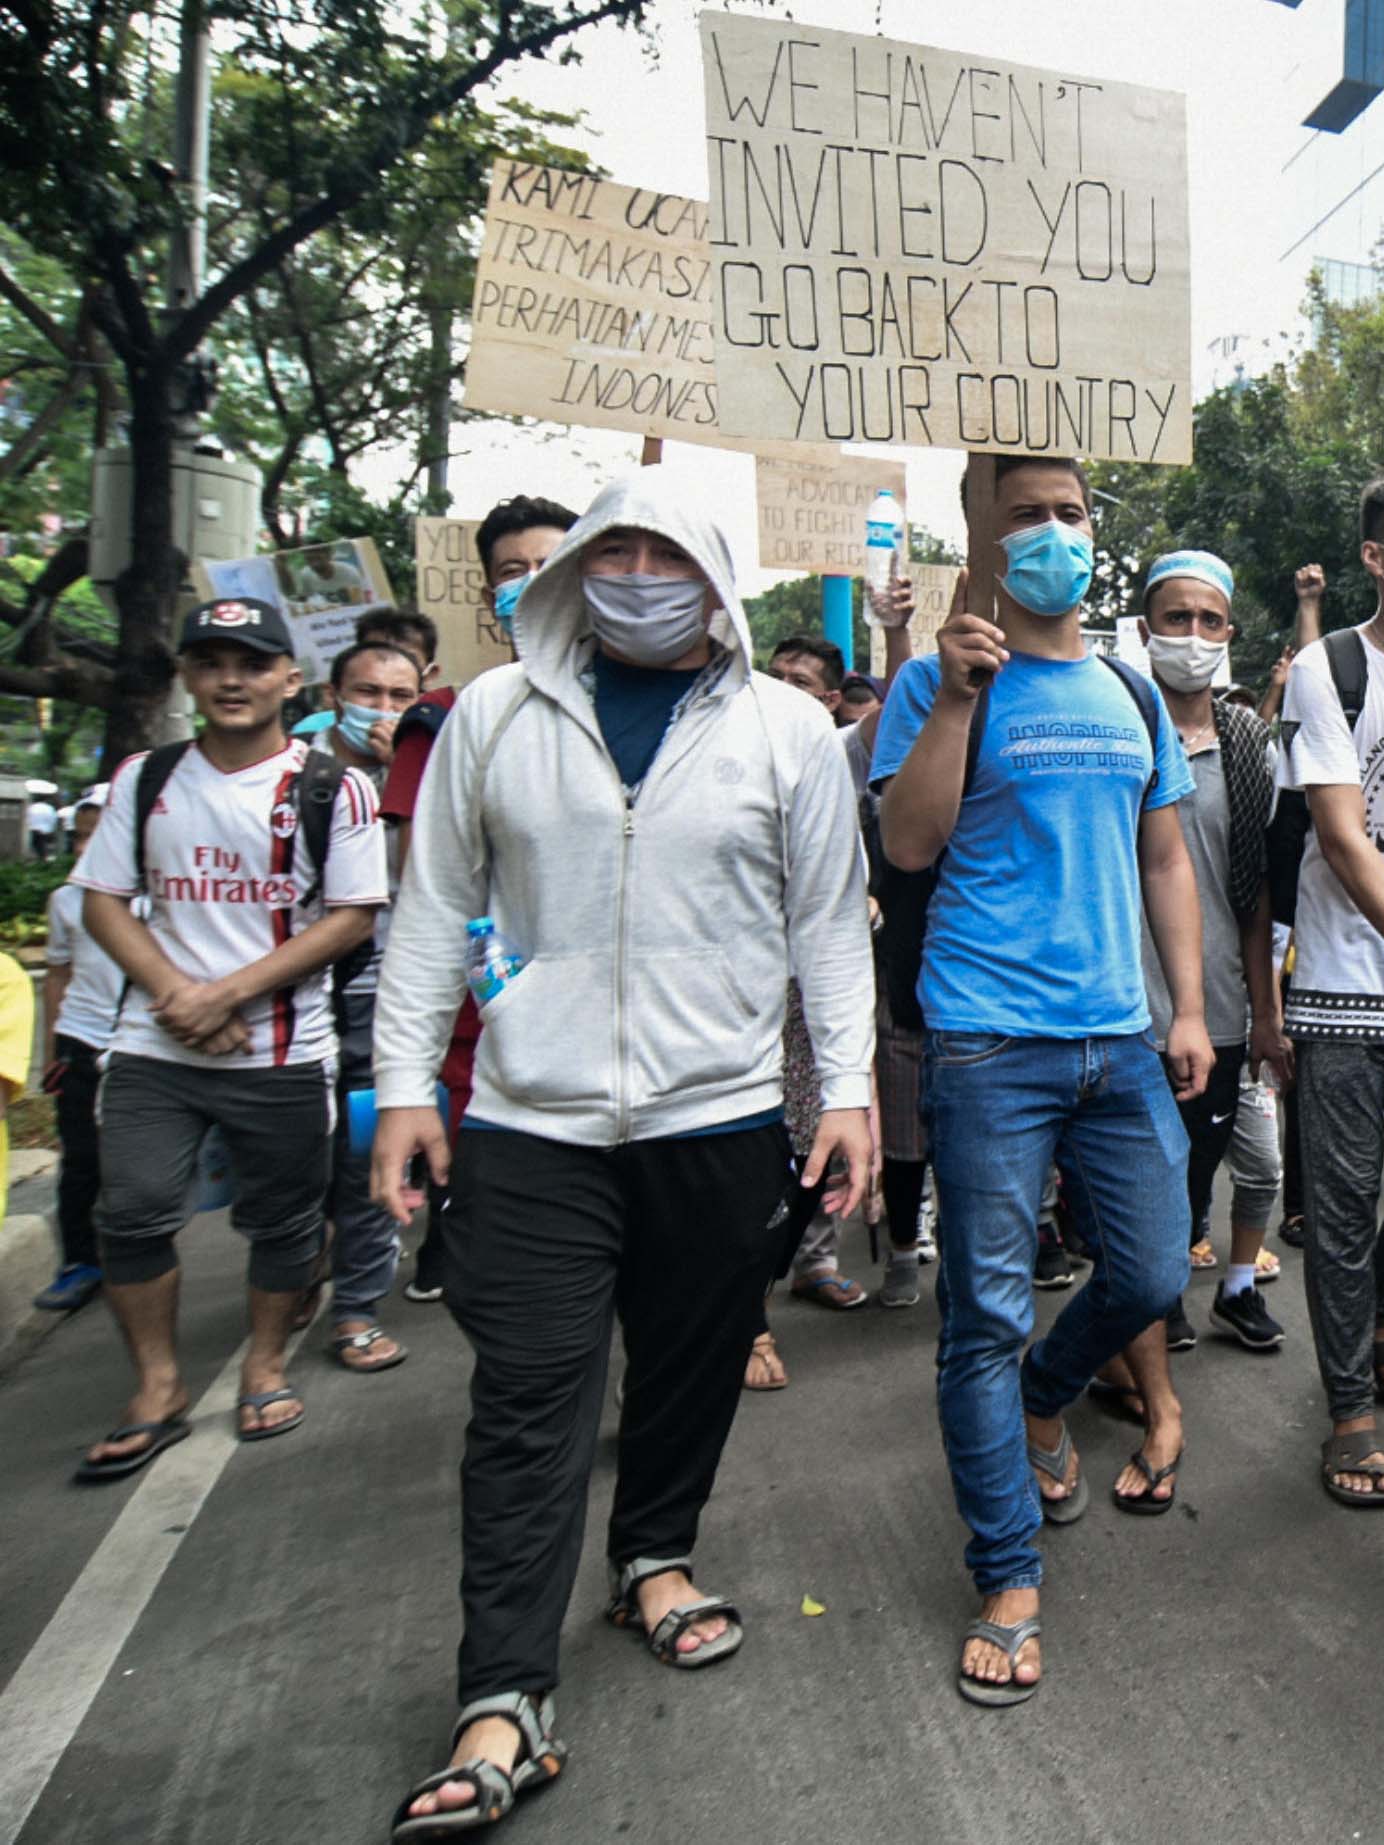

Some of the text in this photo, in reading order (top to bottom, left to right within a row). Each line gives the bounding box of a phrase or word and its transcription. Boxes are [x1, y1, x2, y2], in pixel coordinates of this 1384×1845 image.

[711, 31, 1104, 174] WE HAVEN'T
[501, 163, 603, 220] KAMI
[706, 135, 1157, 285] INVITED YOU
[476, 279, 658, 353] PERHATIAN
[721, 261, 1060, 370] GO BACK TO
[550, 356, 720, 427] INDONES
[775, 361, 1177, 462] YOUR COUNTRY
[763, 504, 785, 531] TO
[194, 846, 241, 873] Fly
